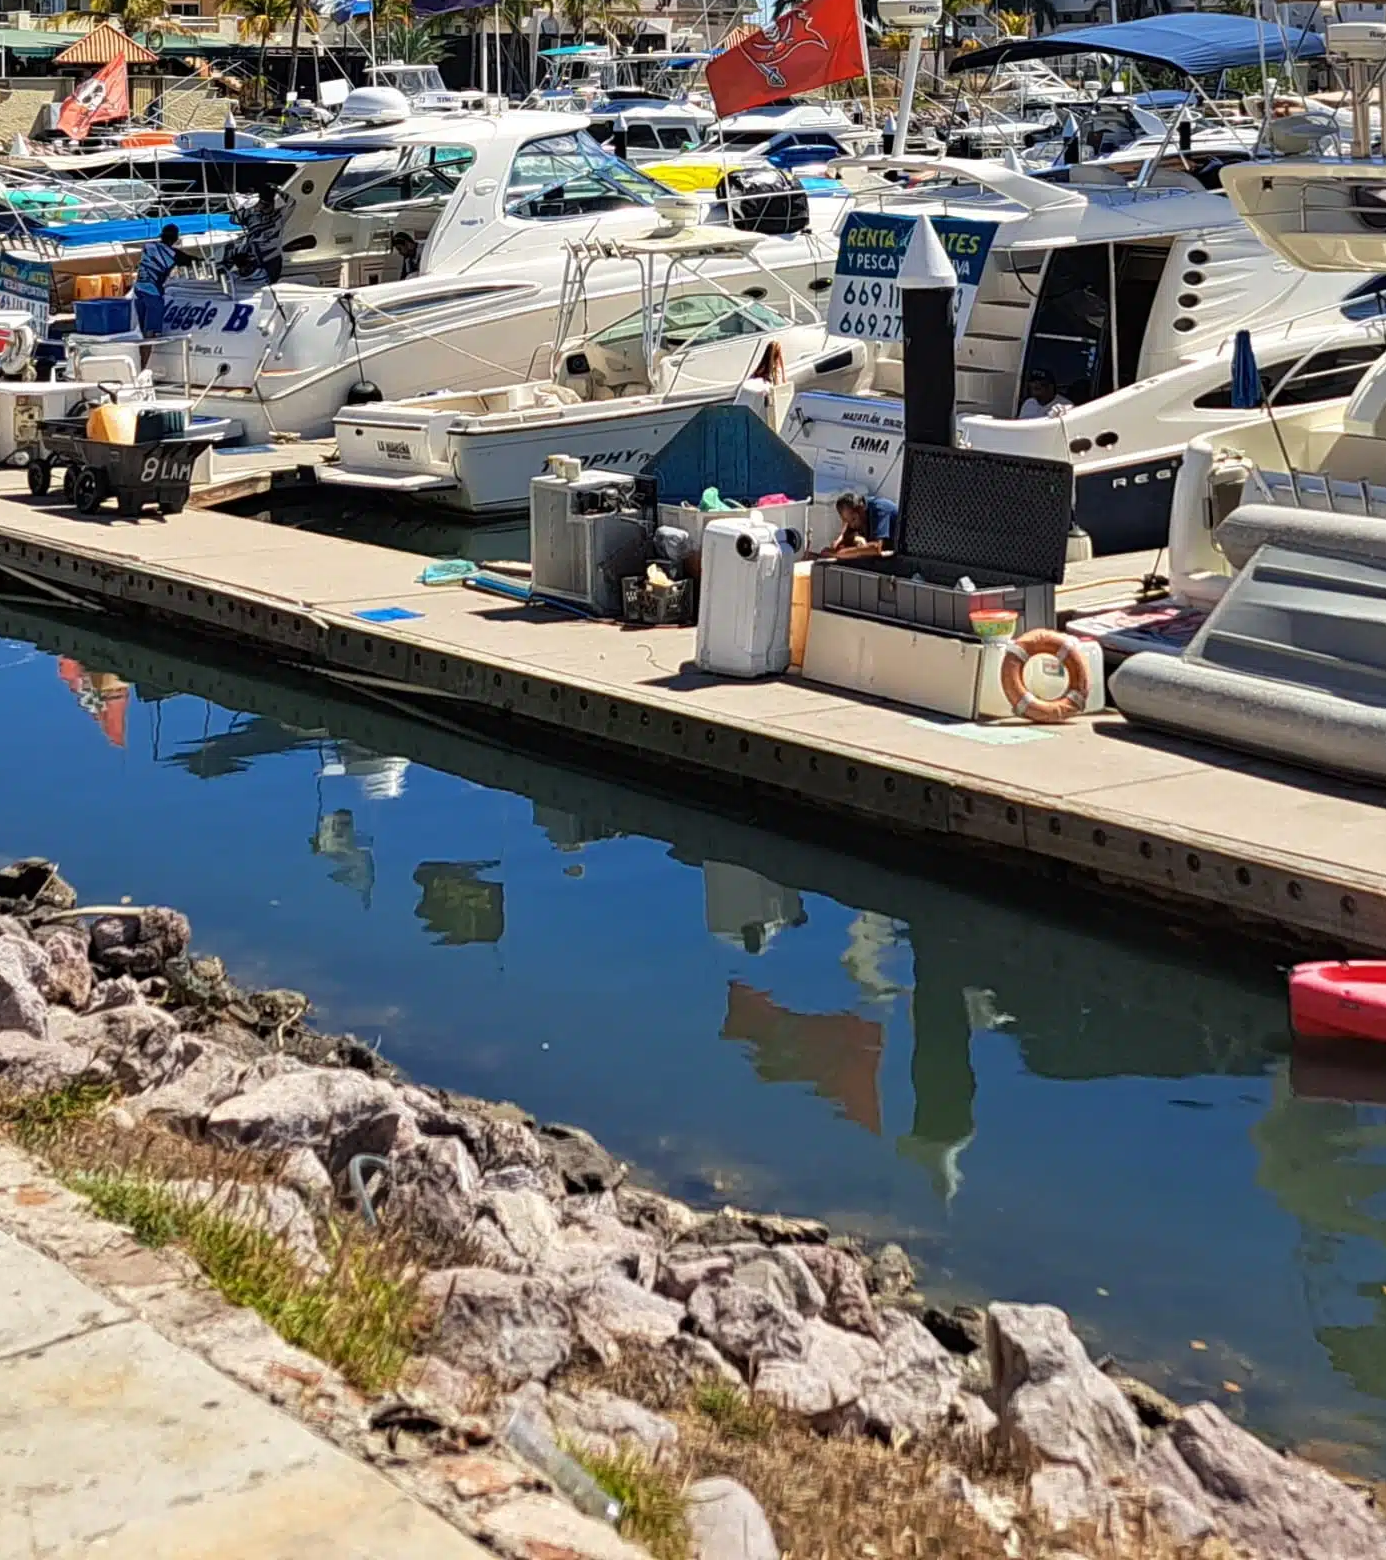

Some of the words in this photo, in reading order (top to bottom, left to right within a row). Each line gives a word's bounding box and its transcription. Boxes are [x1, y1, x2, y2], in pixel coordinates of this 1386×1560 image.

[847, 228, 895, 248] RENTA
[847, 253, 854, 268] Y
[857, 254, 896, 270] PESCA
[221, 303, 255, 332] B
[850, 435, 890, 456] EMMA
[141, 456, 159, 482] 8
[160, 460, 191, 481] LAM
[1112, 468, 1172, 490] REG
